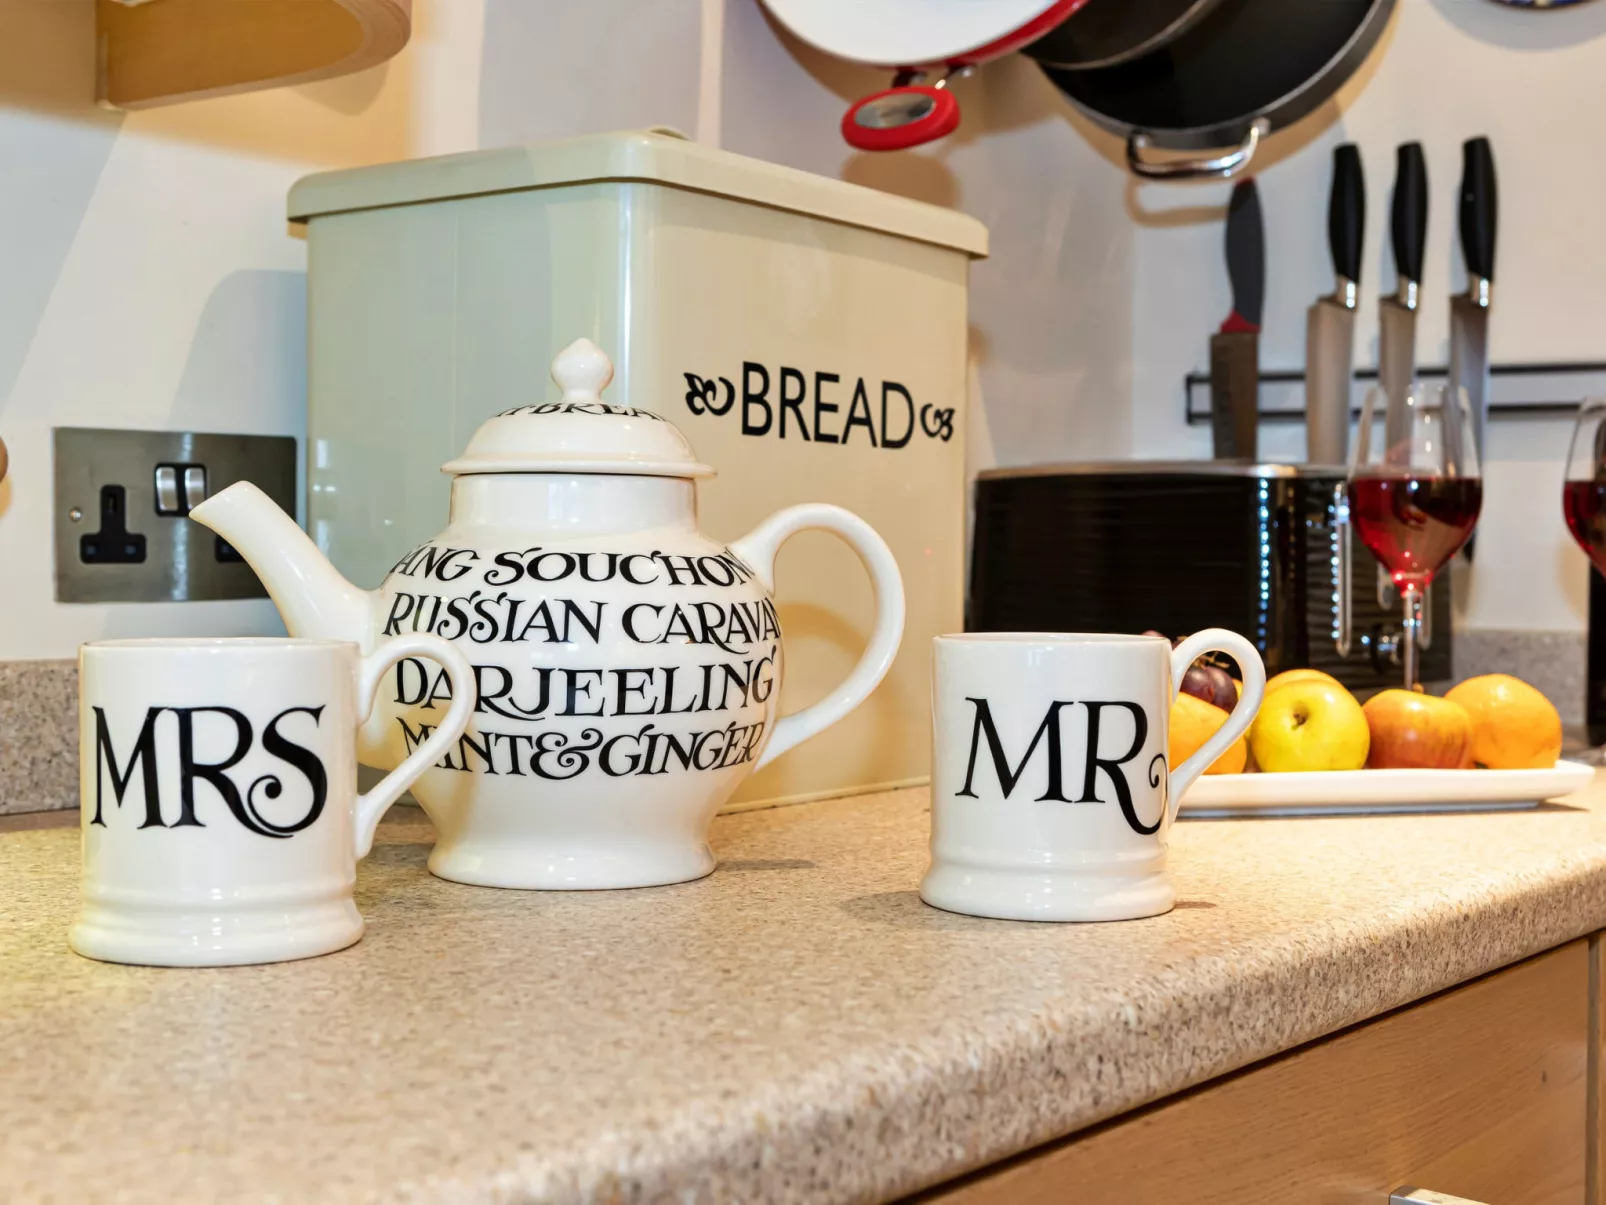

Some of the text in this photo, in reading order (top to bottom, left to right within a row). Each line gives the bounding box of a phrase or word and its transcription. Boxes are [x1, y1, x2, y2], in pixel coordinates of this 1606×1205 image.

[742, 361, 915, 449] BREAD
[389, 540, 756, 587] ANG SOUCHON
[382, 590, 609, 645] RUSSIAN
[393, 645, 777, 721] DARJEELING
[90, 704, 328, 839] MRS
[955, 697, 1169, 836] MR
